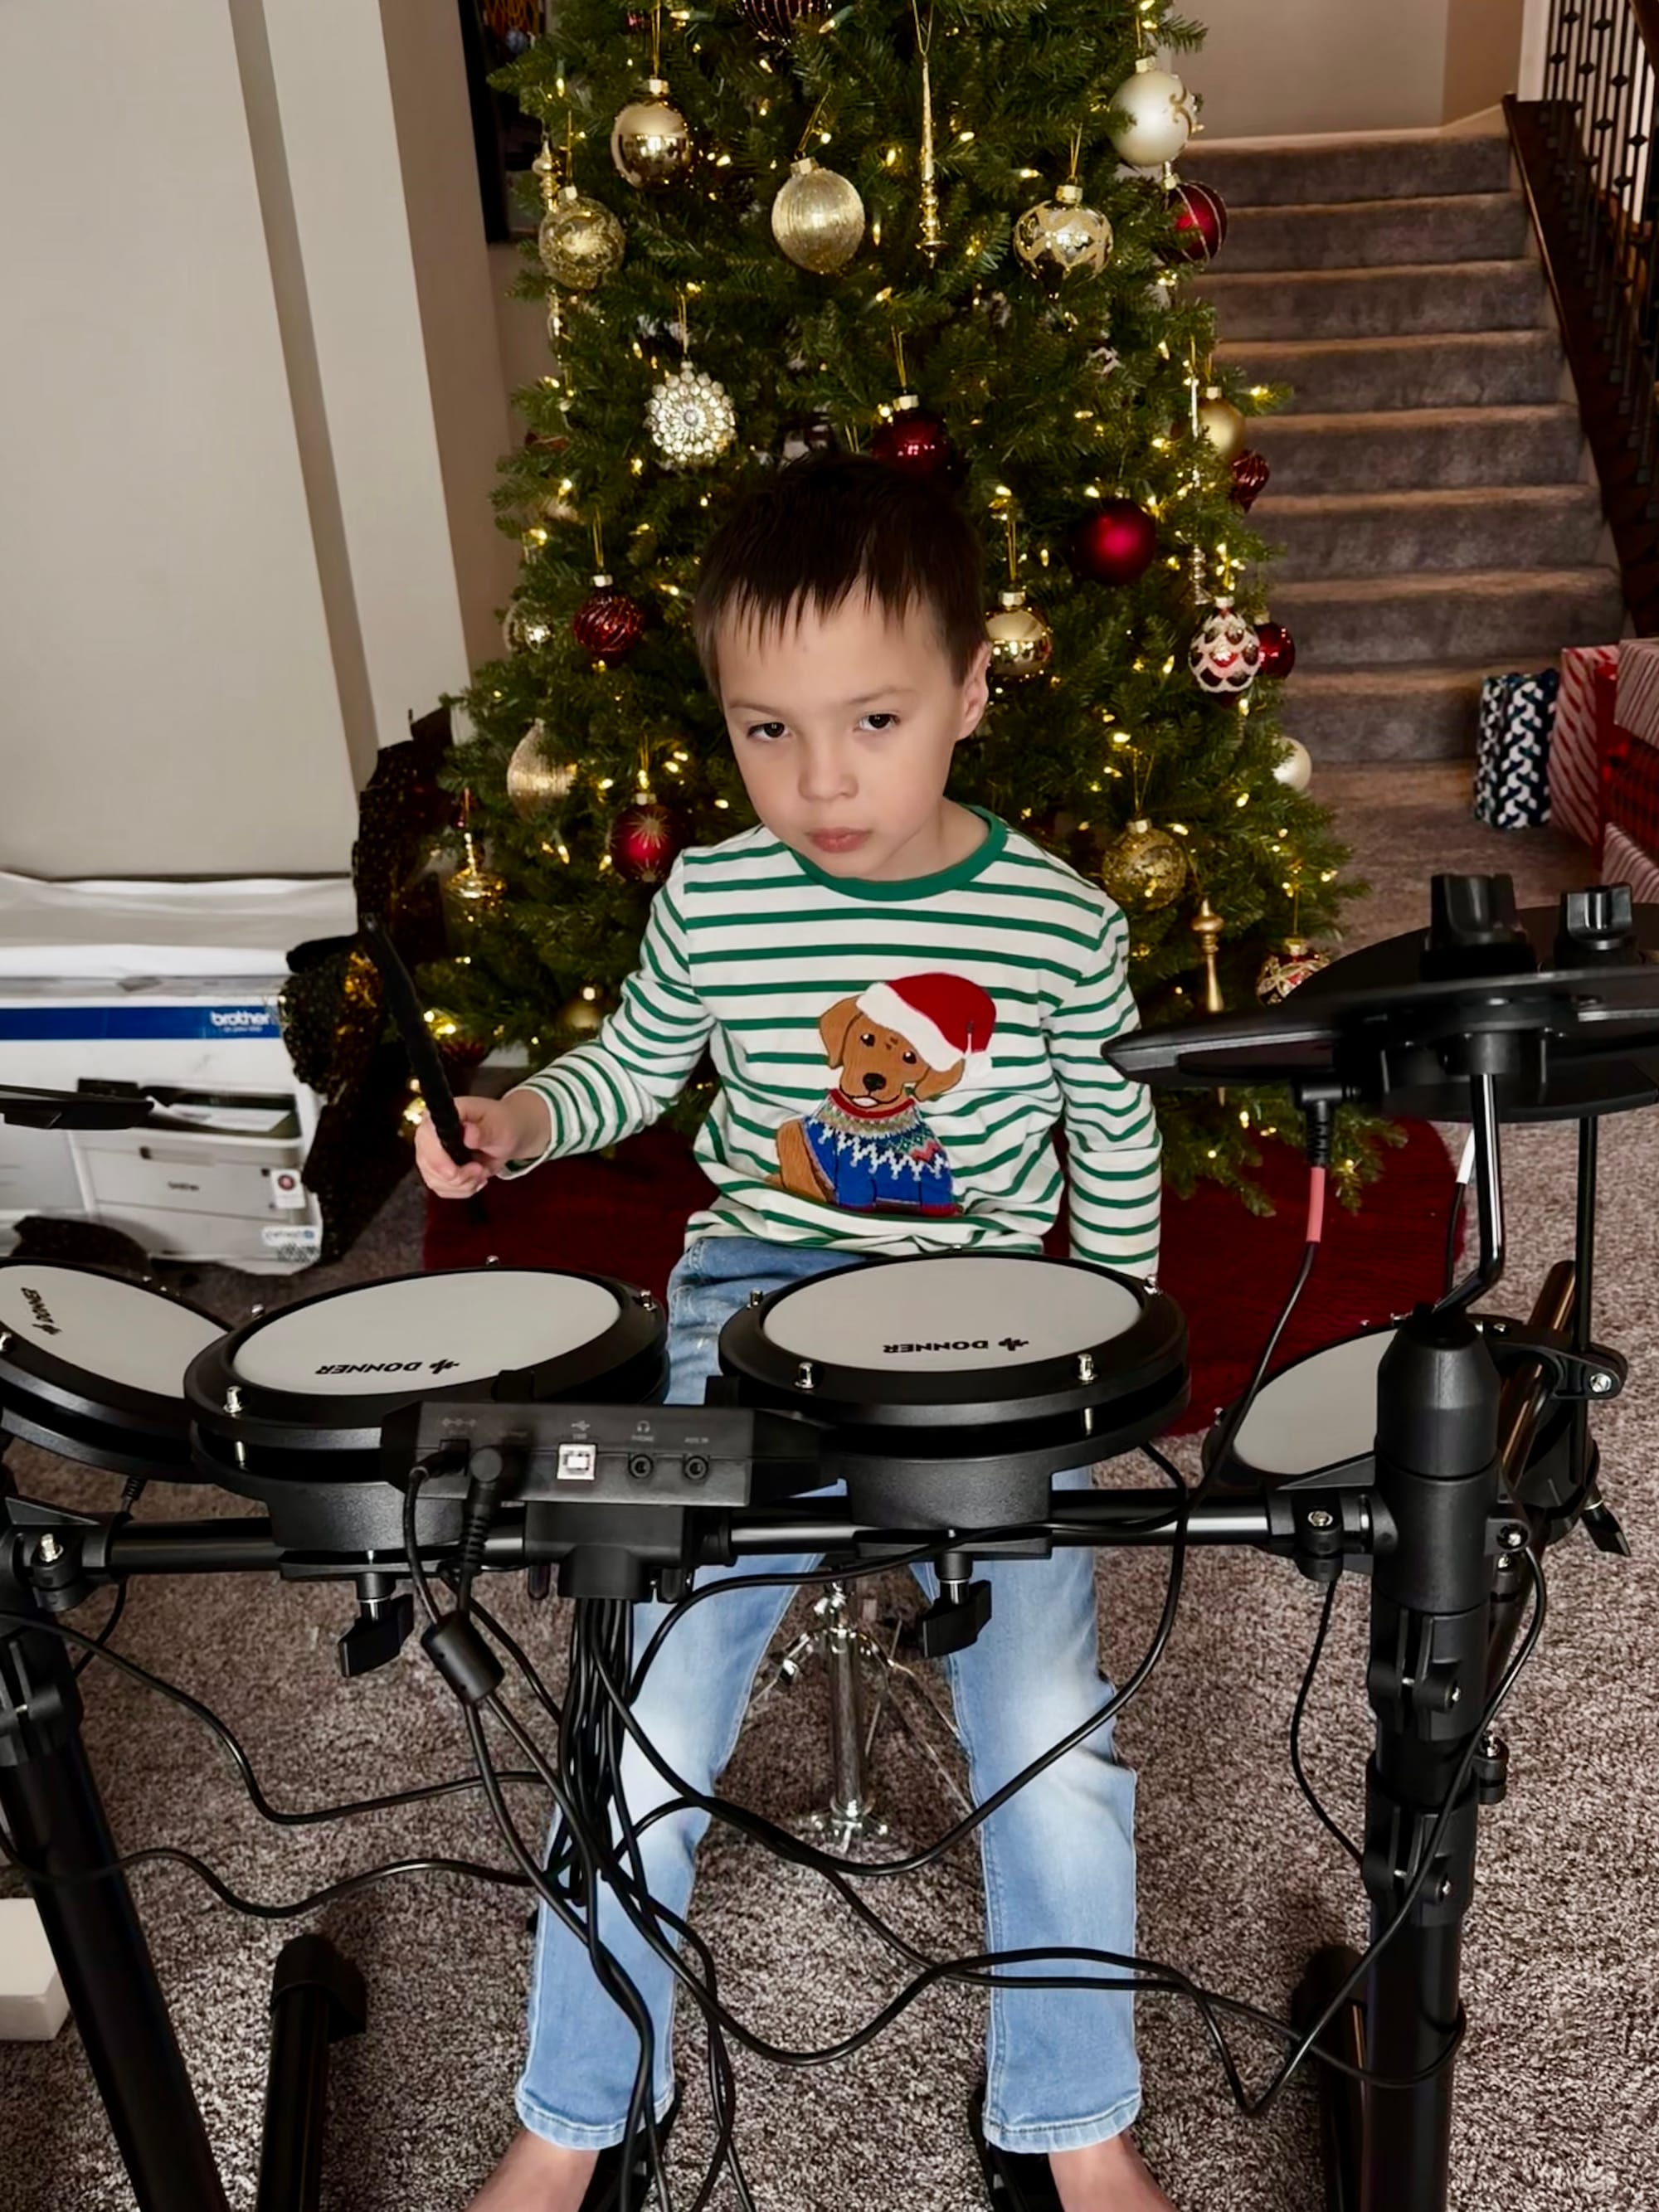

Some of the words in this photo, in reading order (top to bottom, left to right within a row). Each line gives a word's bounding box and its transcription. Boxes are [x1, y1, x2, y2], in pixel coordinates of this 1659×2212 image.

[210, 1010, 270, 1026] brother
[883, 1339, 989, 1354] DONNER
[315, 1362, 423, 1376] DONNER
